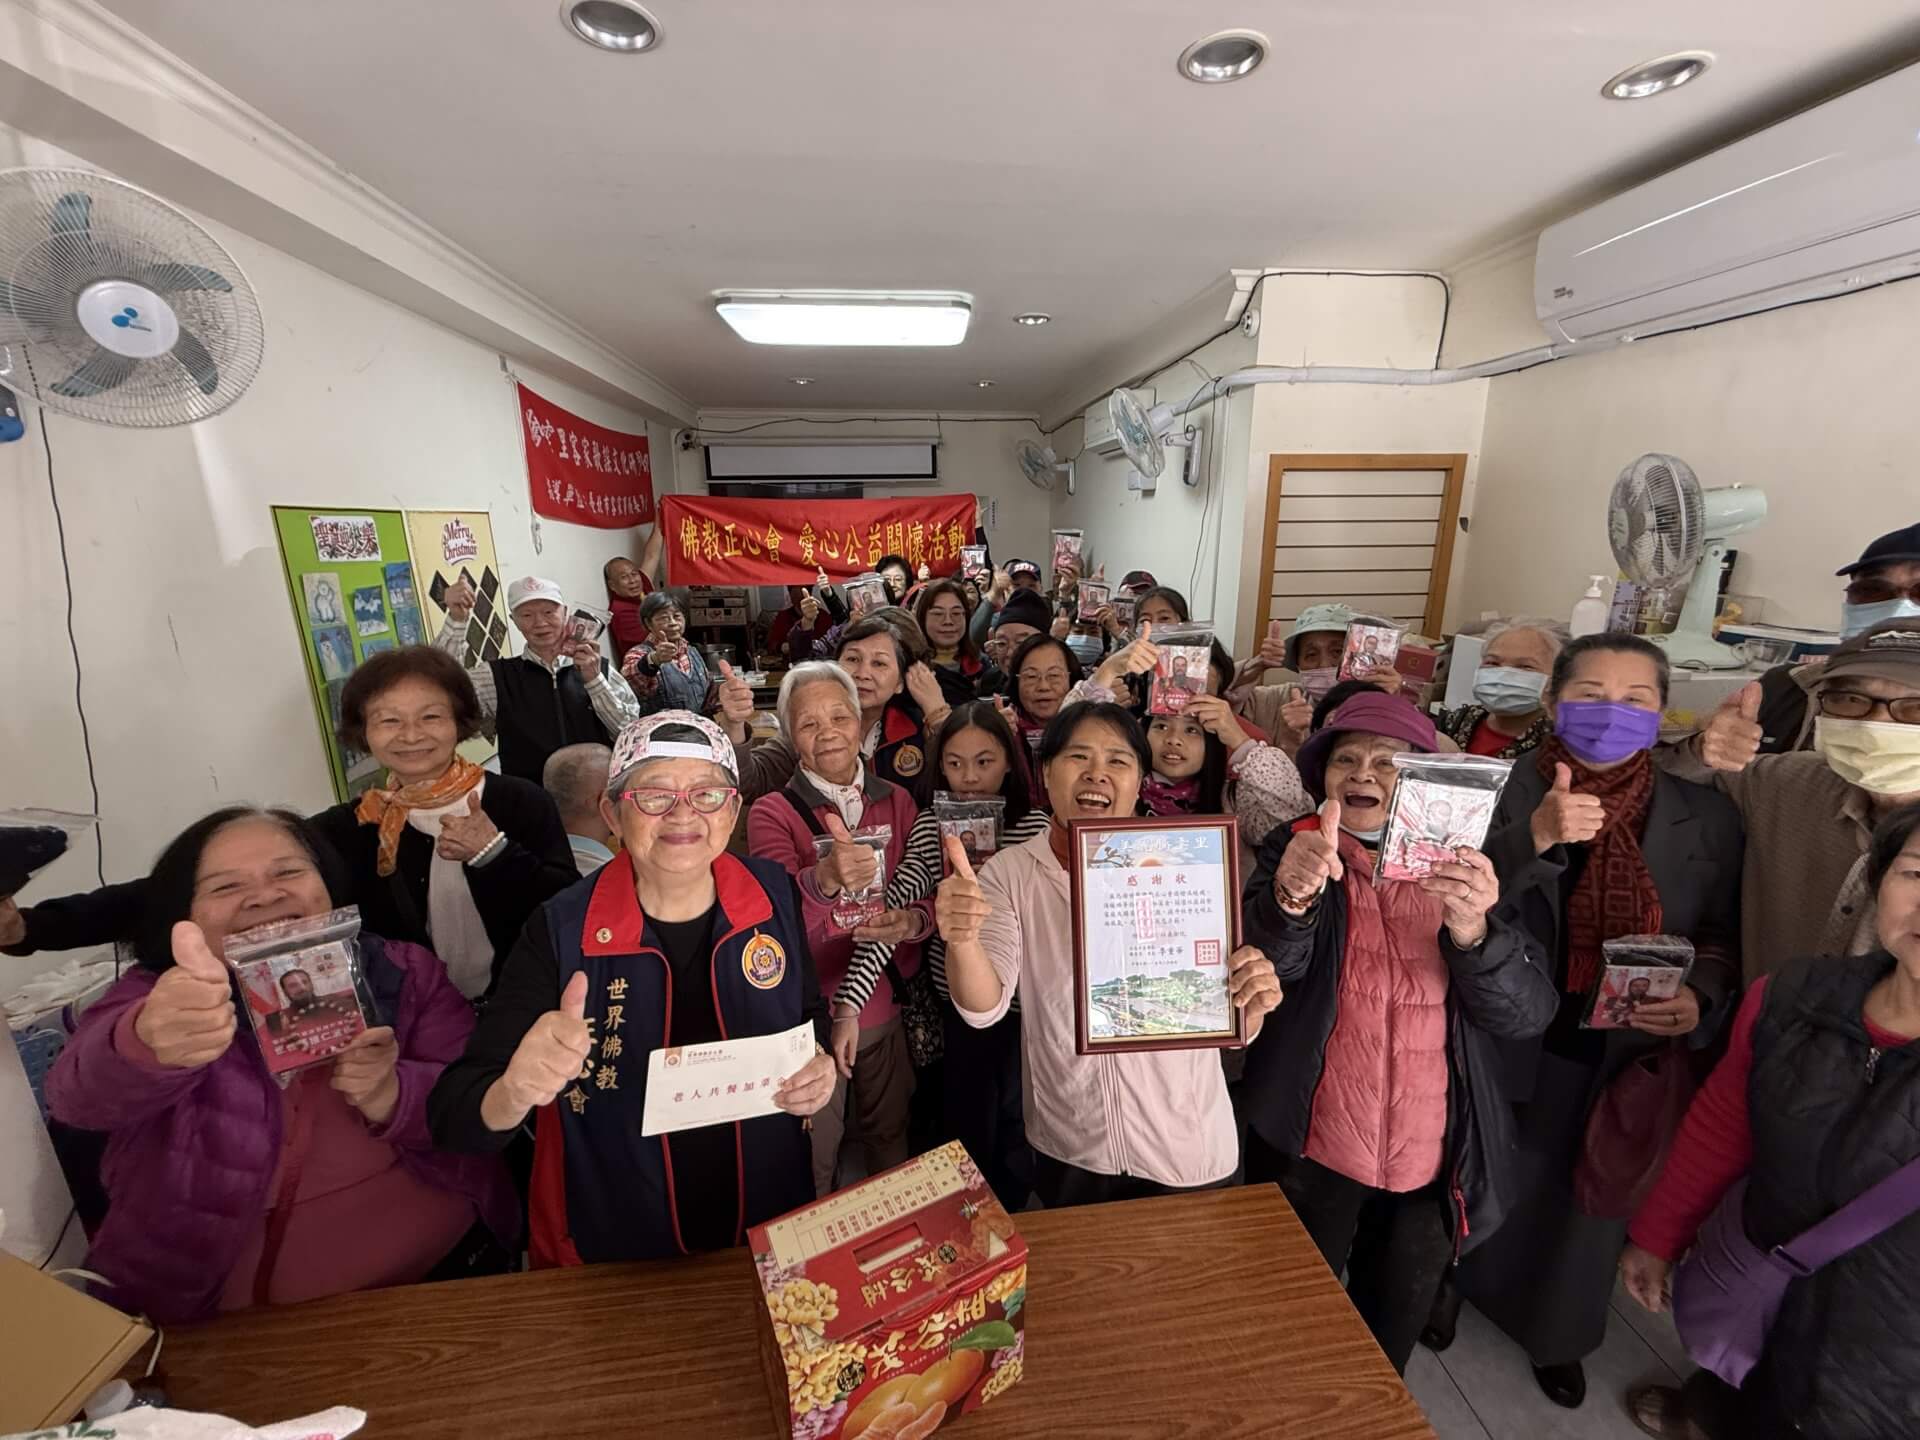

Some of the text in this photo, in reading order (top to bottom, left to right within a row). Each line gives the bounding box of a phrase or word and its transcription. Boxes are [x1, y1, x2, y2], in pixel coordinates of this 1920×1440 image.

[443, 522, 472, 541] Merry
[680, 517, 967, 567] 佛教正心會 愛心公益關懷活動
[1127, 872, 1187, 886] 感謝狀
[596, 977, 629, 1090] 世界佛教
